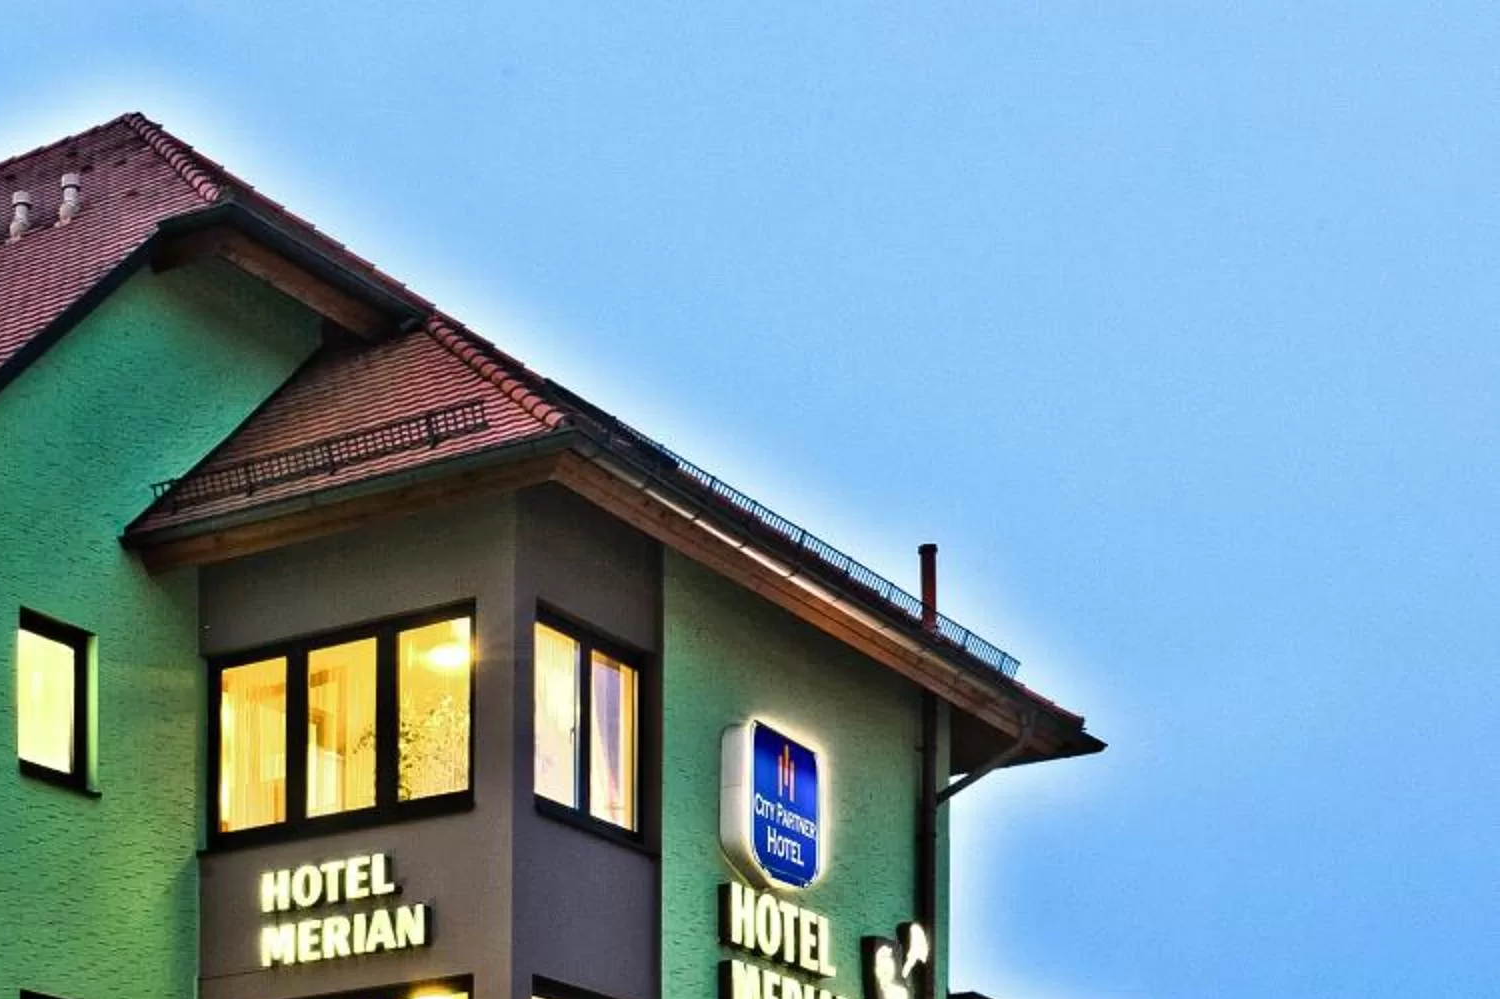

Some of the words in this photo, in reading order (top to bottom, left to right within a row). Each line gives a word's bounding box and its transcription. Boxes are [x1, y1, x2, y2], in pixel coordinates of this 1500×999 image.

[755, 792, 775, 821] CITY
[775, 802, 816, 840] PARTNER
[767, 825, 805, 867] HOTEL
[261, 852, 395, 913] HOTEL
[261, 903, 425, 967] MERIAN
[731, 881, 837, 977] HOTEL
